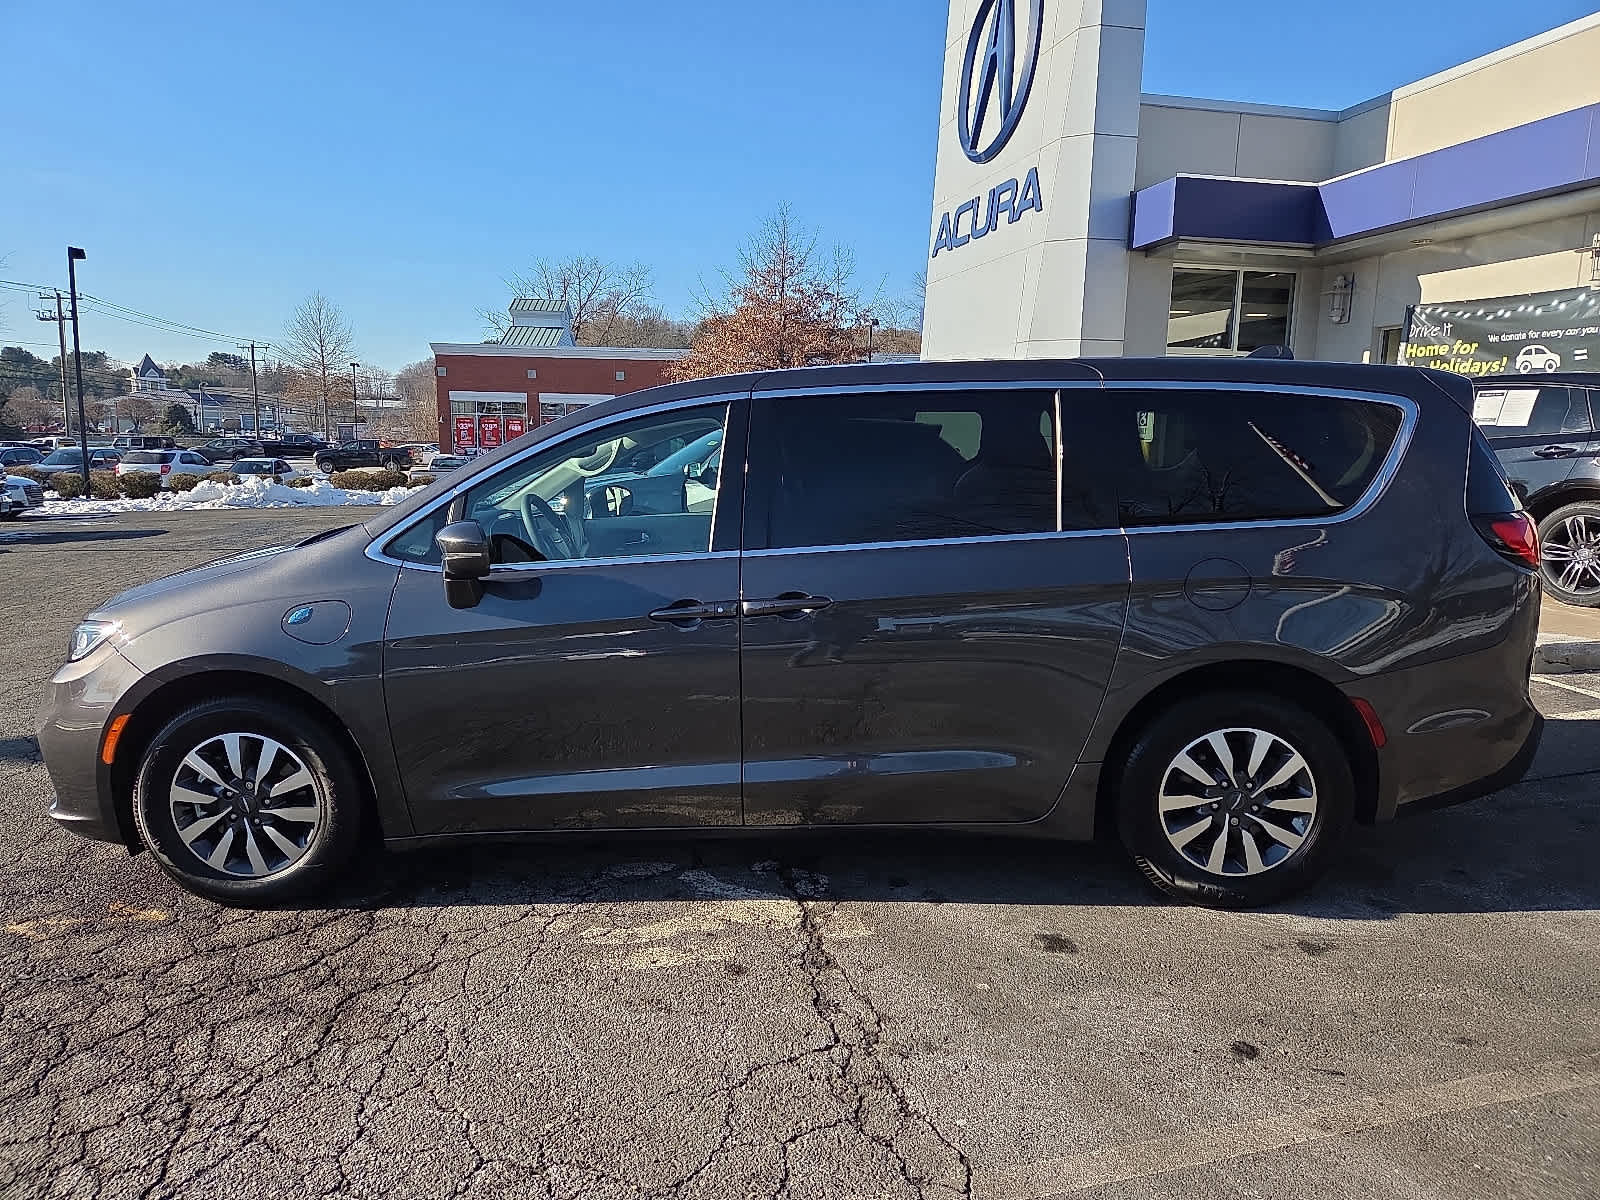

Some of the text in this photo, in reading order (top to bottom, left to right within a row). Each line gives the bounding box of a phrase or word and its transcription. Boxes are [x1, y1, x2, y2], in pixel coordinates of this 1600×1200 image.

[932, 167, 1043, 258] ACURA
[1409, 324, 1440, 338] Drive
[1488, 326, 1599, 343] We donate for every car you
[1405, 339, 1479, 358] Home for
